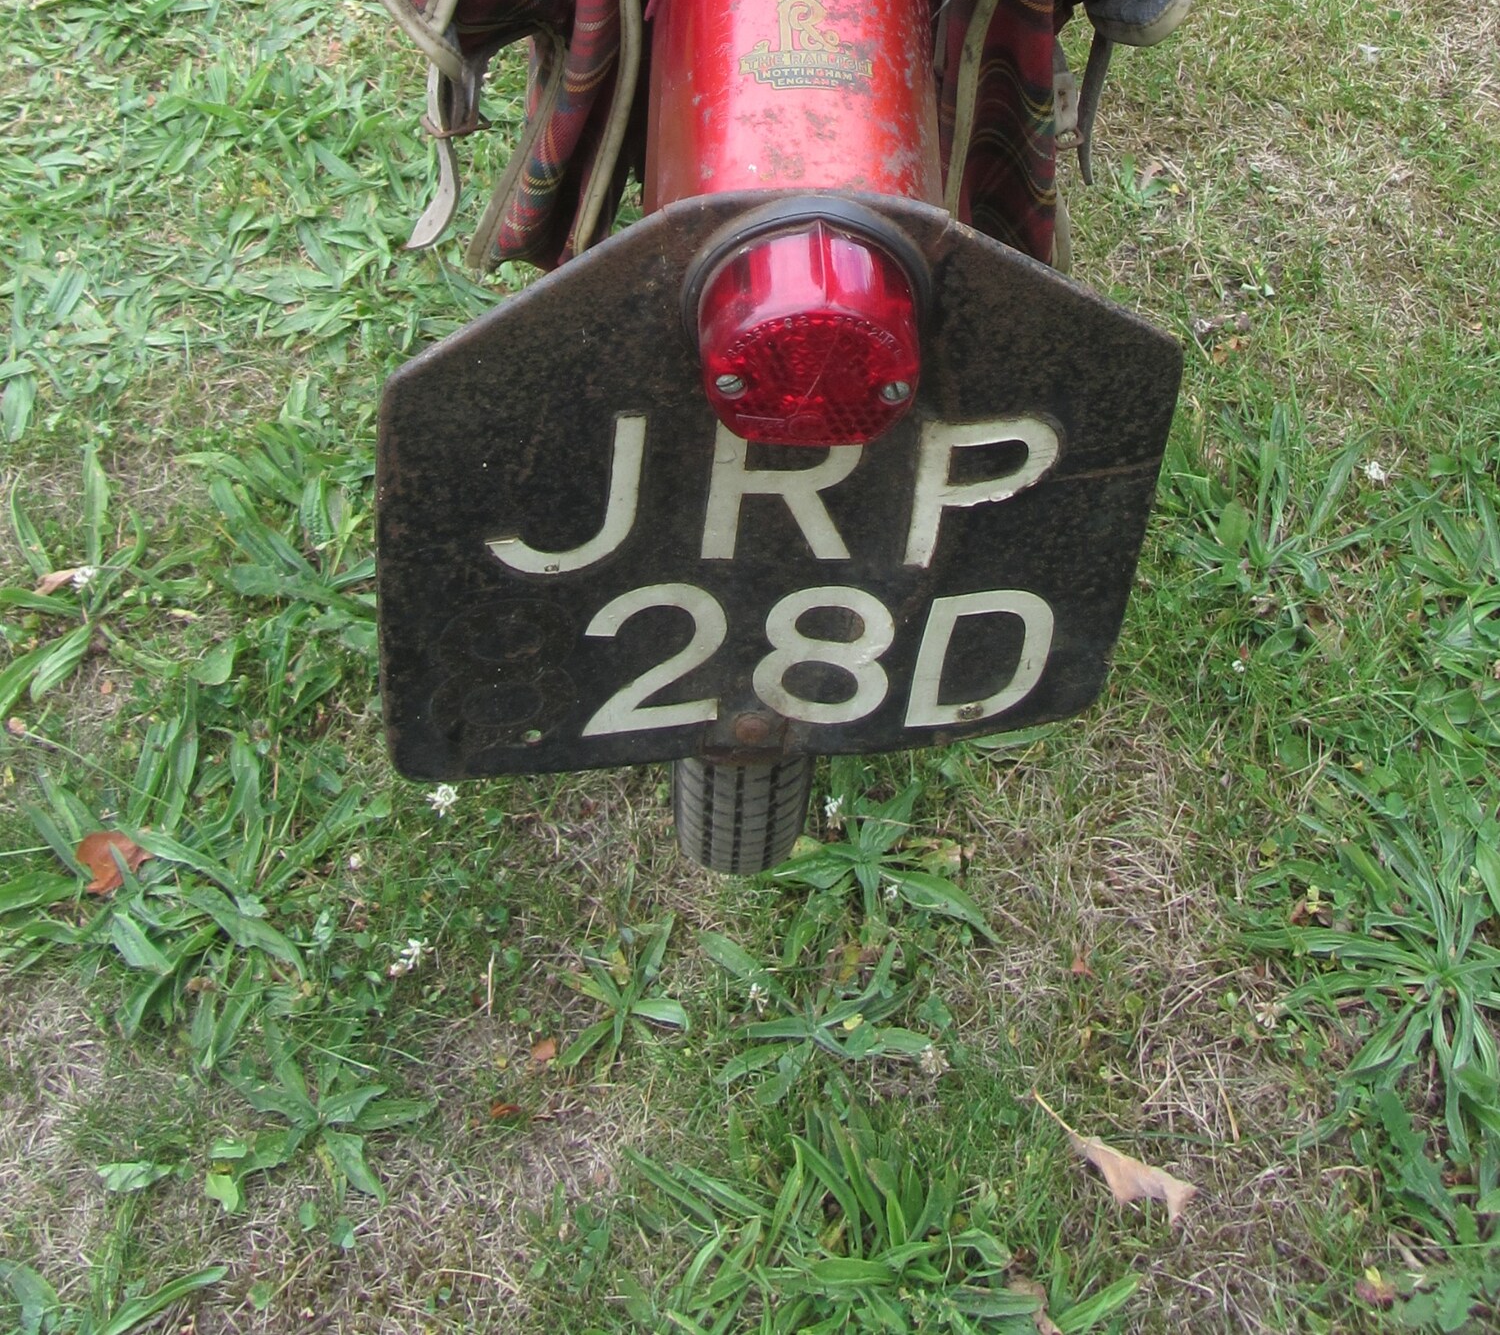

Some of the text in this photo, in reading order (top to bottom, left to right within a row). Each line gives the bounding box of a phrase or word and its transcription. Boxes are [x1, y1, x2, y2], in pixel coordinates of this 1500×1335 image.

[747, 53, 785, 70] THE
[762, 67, 853, 81] NOTTINGHAM
[484, 414, 1062, 575] JRP
[581, 583, 1055, 737] 28D
